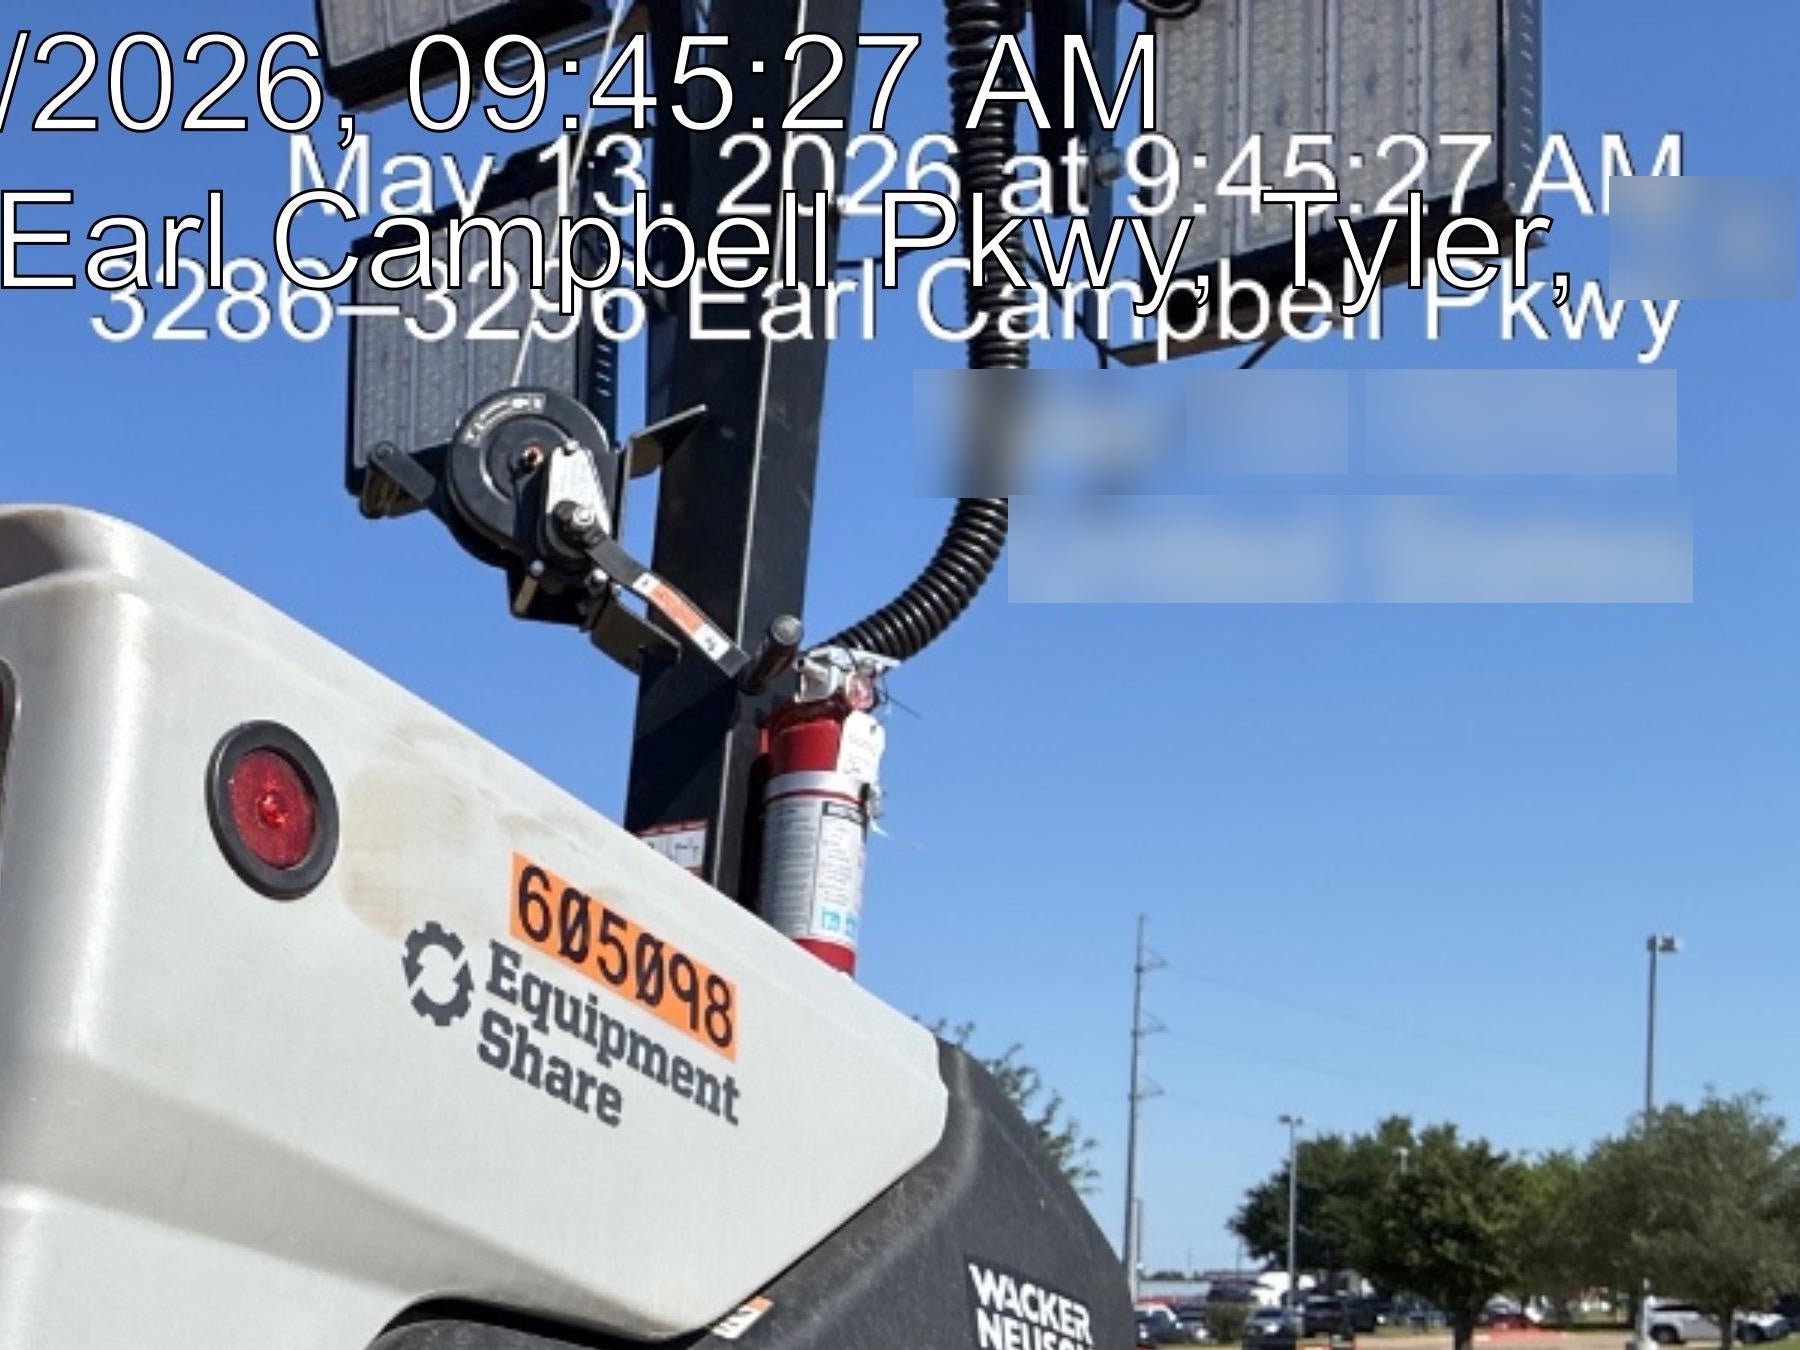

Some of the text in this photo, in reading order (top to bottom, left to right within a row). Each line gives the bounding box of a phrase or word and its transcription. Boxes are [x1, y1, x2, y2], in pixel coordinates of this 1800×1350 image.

[485, 937, 741, 1126] Equipment
[517, 864, 734, 1048] 605098
[477, 1007, 623, 1128] Share
[968, 1262, 1093, 1344] WACKER
